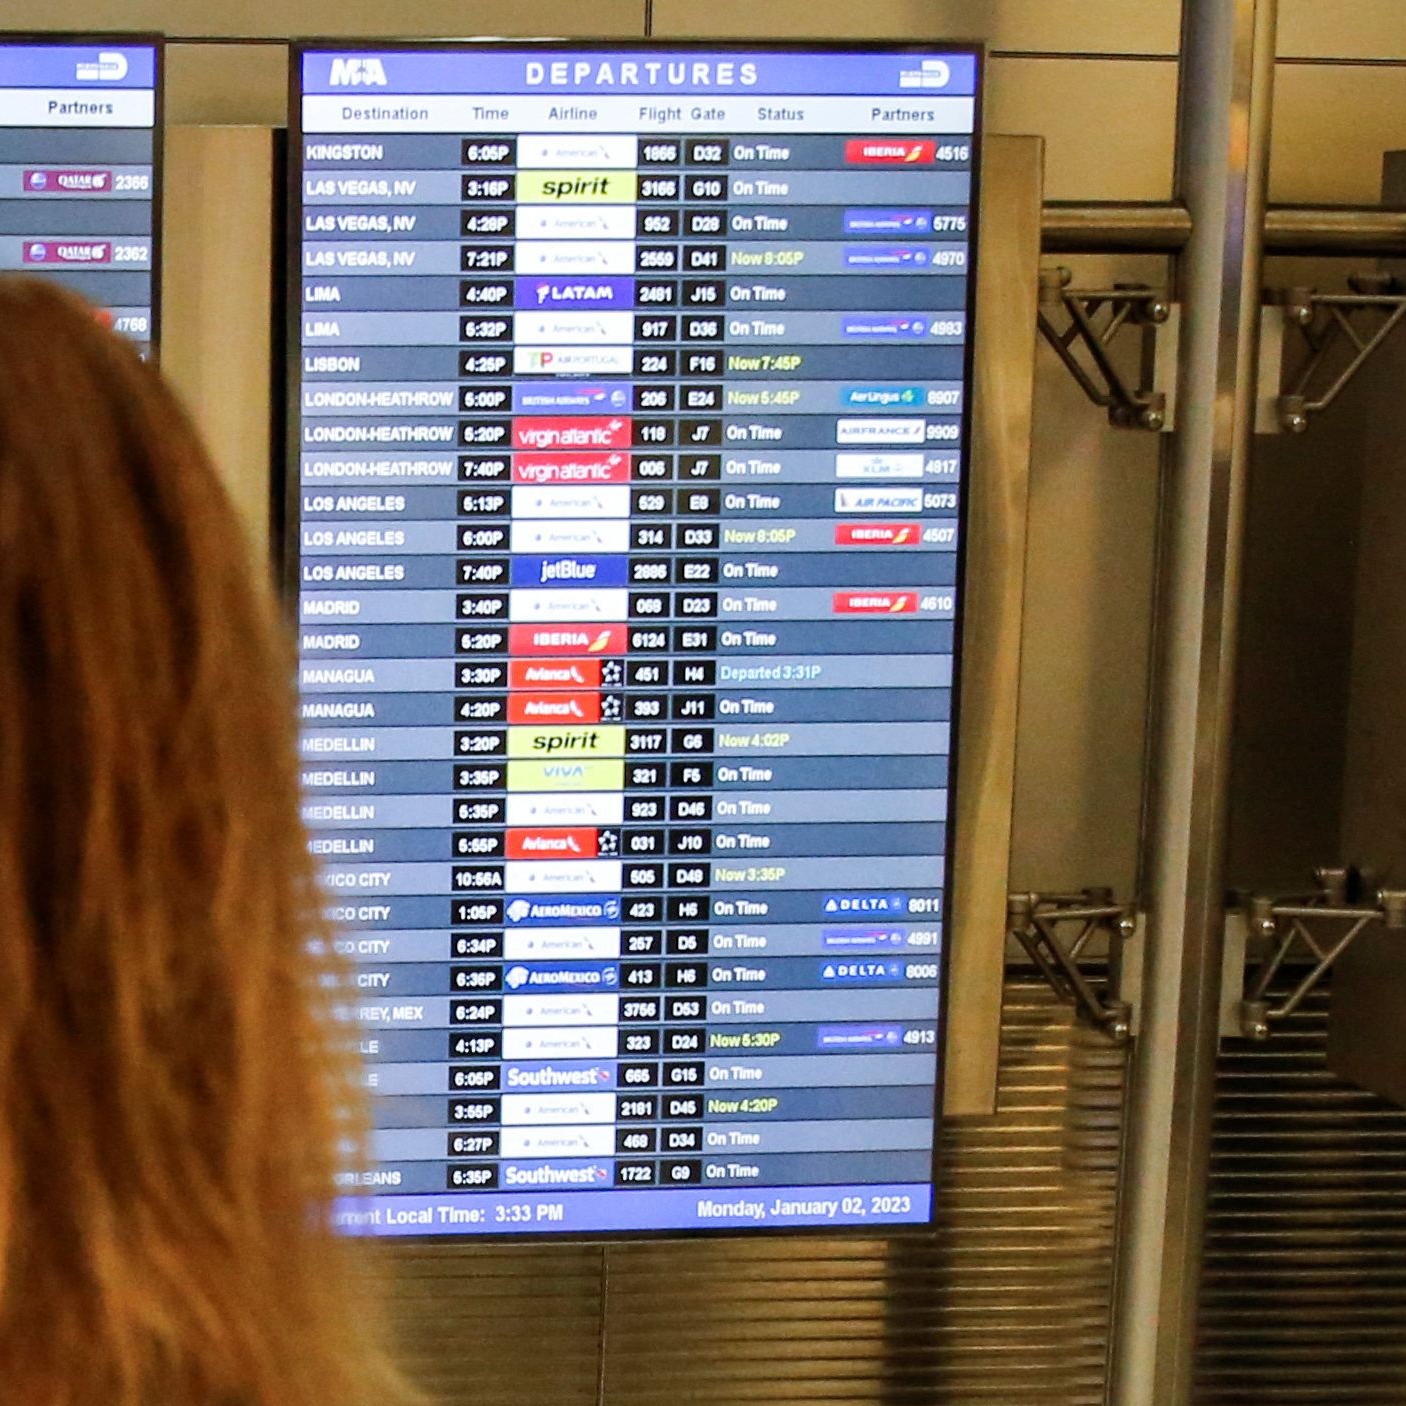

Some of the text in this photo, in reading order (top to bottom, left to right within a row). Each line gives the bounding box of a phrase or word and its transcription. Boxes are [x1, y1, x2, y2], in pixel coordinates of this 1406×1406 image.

[527, 63, 757, 84] DEPARTURES
[49, 101, 112, 113] Partners
[343, 107, 934, 123] Destination Time Airline Flight Gate Status Partners
[307, 145, 968, 160] KINGSTON 6:05P D32 On Time IBERIA 4516
[304, 560, 778, 582] LOS ANGELES 7:40P jetBlue E22 On Time
[387, 1207, 432, 1224] Local
[437, 1207, 484, 1223] Time:
[496, 1205, 531, 1221] 3:33
[537, 1204, 563, 1221] PM
[698, 1200, 765, 1219] Monday,
[770, 1199, 838, 1217] January
[842, 1198, 865, 1216] 02,
[872, 1197, 910, 1213] 2023
